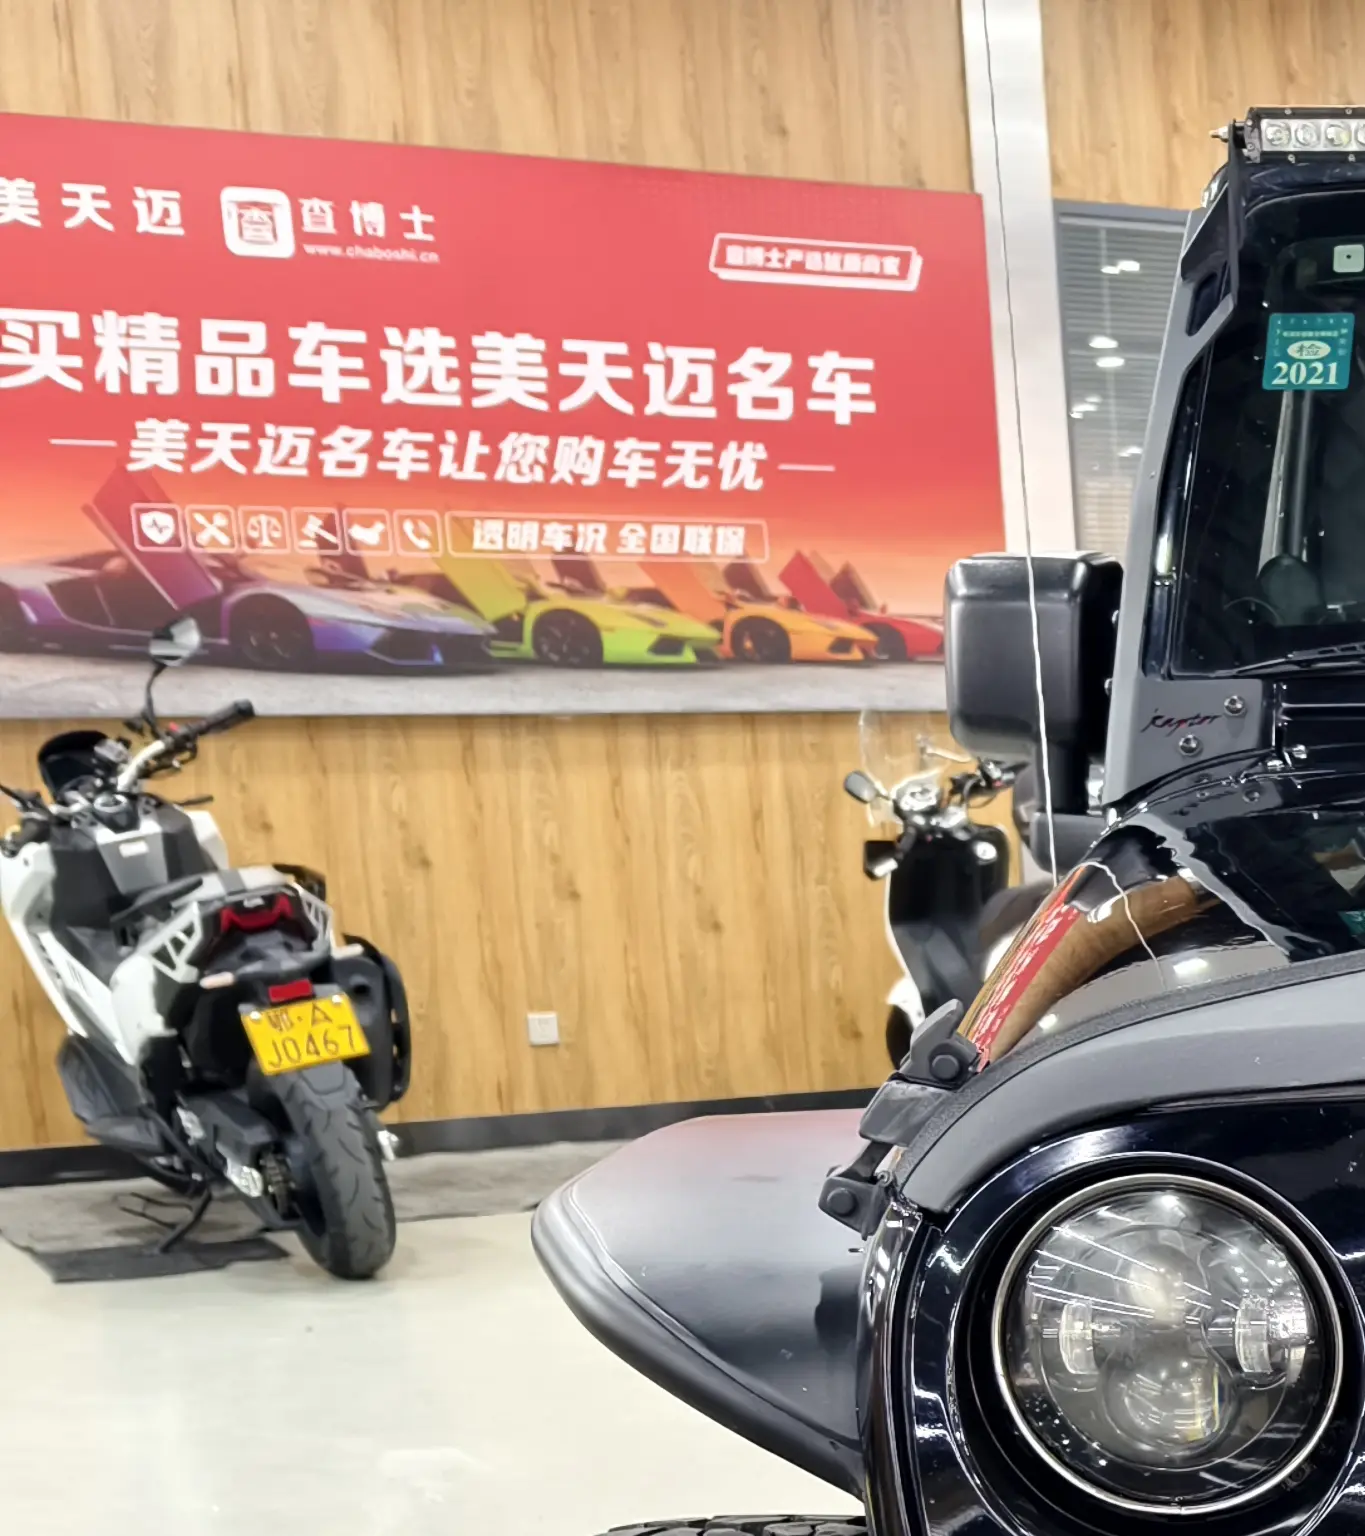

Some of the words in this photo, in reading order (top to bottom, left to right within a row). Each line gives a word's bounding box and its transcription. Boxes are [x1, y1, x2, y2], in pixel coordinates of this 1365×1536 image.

[0, 176, 186, 236] 美天迈
[298, 197, 436, 241] 查博士
[0, 306, 878, 426] 买精品车选美天迈名车
[1271, 361, 1338, 385] 2021
[128, 417, 769, 491] 美天迈名车让您购车无忧
